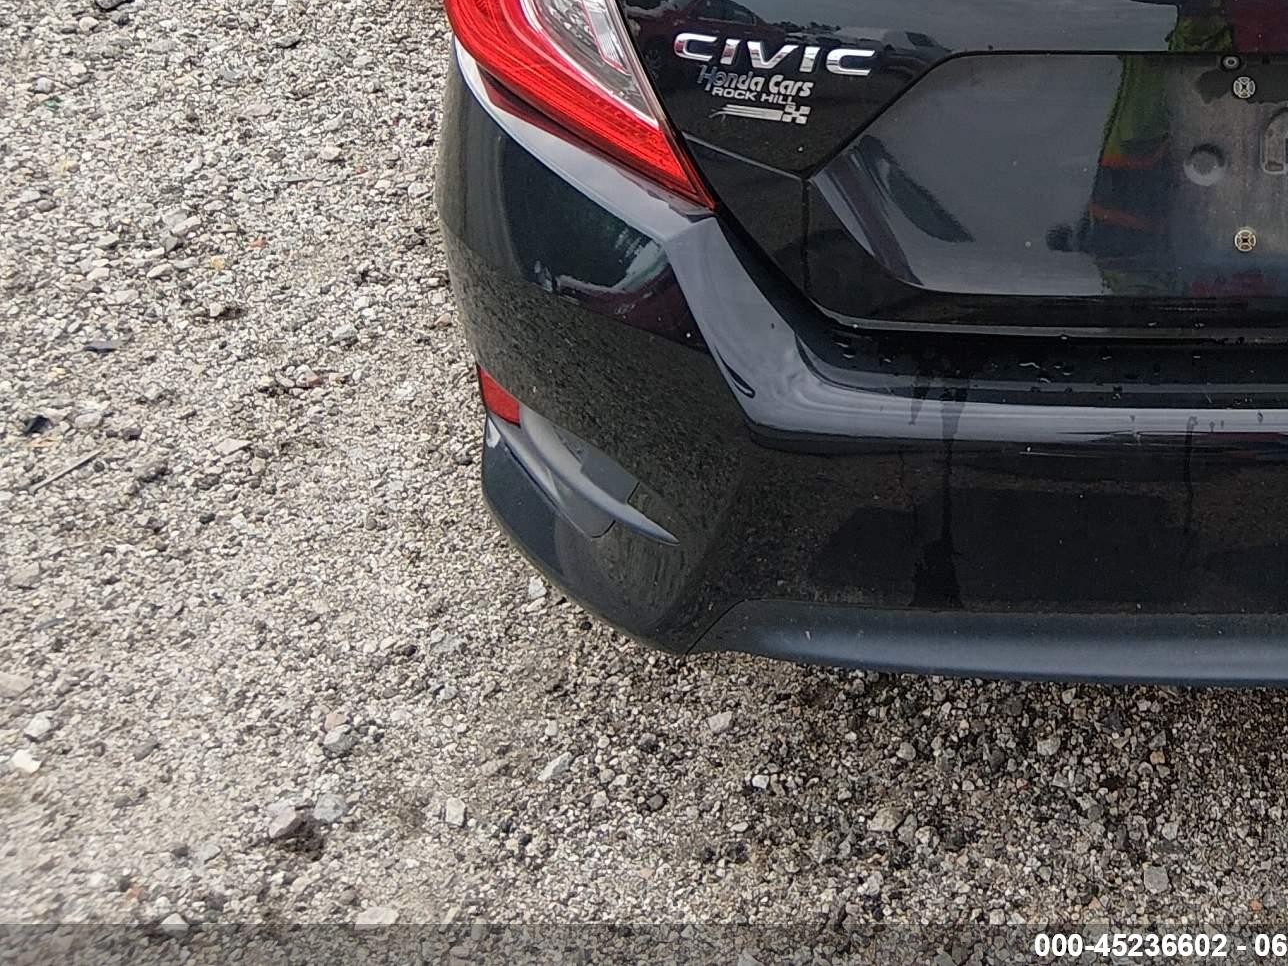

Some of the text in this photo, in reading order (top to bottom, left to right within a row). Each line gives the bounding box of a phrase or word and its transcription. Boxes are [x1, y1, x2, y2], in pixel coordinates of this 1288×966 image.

[673, 31, 876, 76] CIVIC
[696, 64, 815, 98] Honda Cars
[711, 86, 758, 101] ROCK
